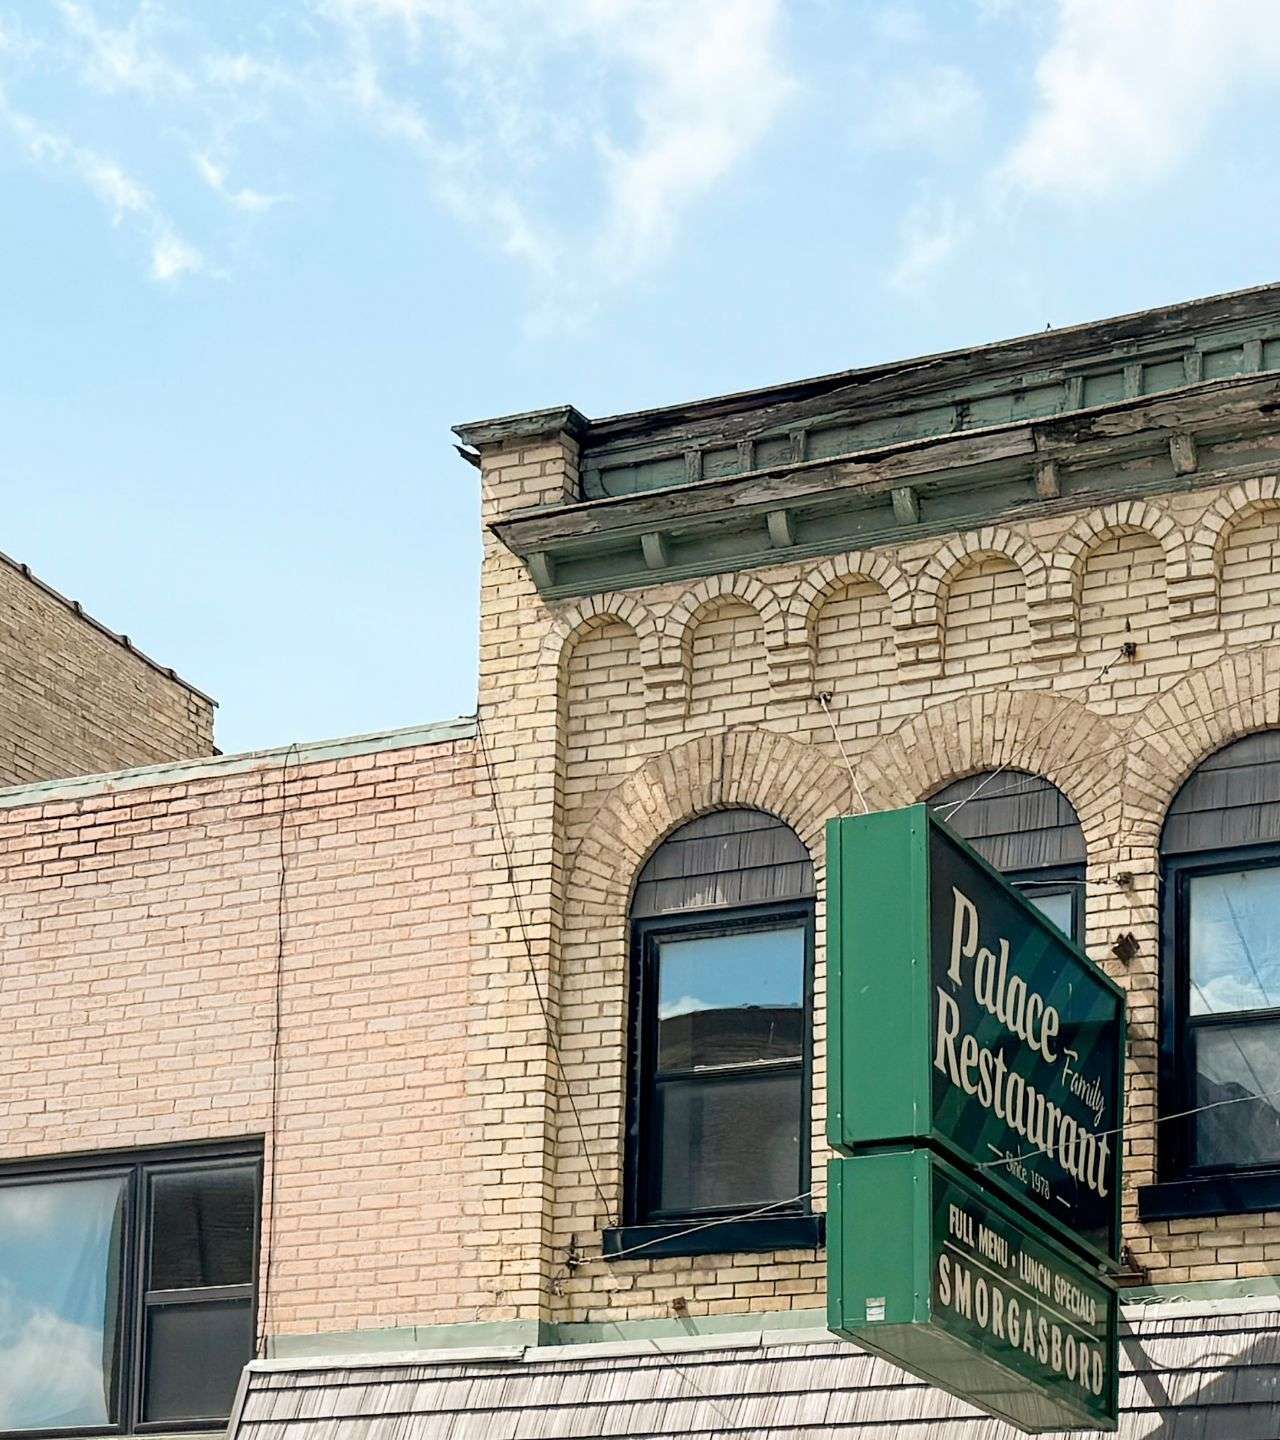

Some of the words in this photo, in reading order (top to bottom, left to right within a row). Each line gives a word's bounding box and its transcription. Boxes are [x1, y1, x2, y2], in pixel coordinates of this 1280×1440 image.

[948, 886, 1059, 1063] Palace
[934, 986, 1110, 1197] Restaurant
[1061, 1048, 1105, 1127] Family
[1005, 1150, 1027, 1184] Since
[939, 1254, 1103, 1396] SMORGASBORD
[949, 1203, 974, 1248] FULL
[978, 1223, 1008, 1268] MENU
[1020, 1250, 1051, 1297] LUNCH
[1054, 1274, 1096, 1326] SPECIALS
